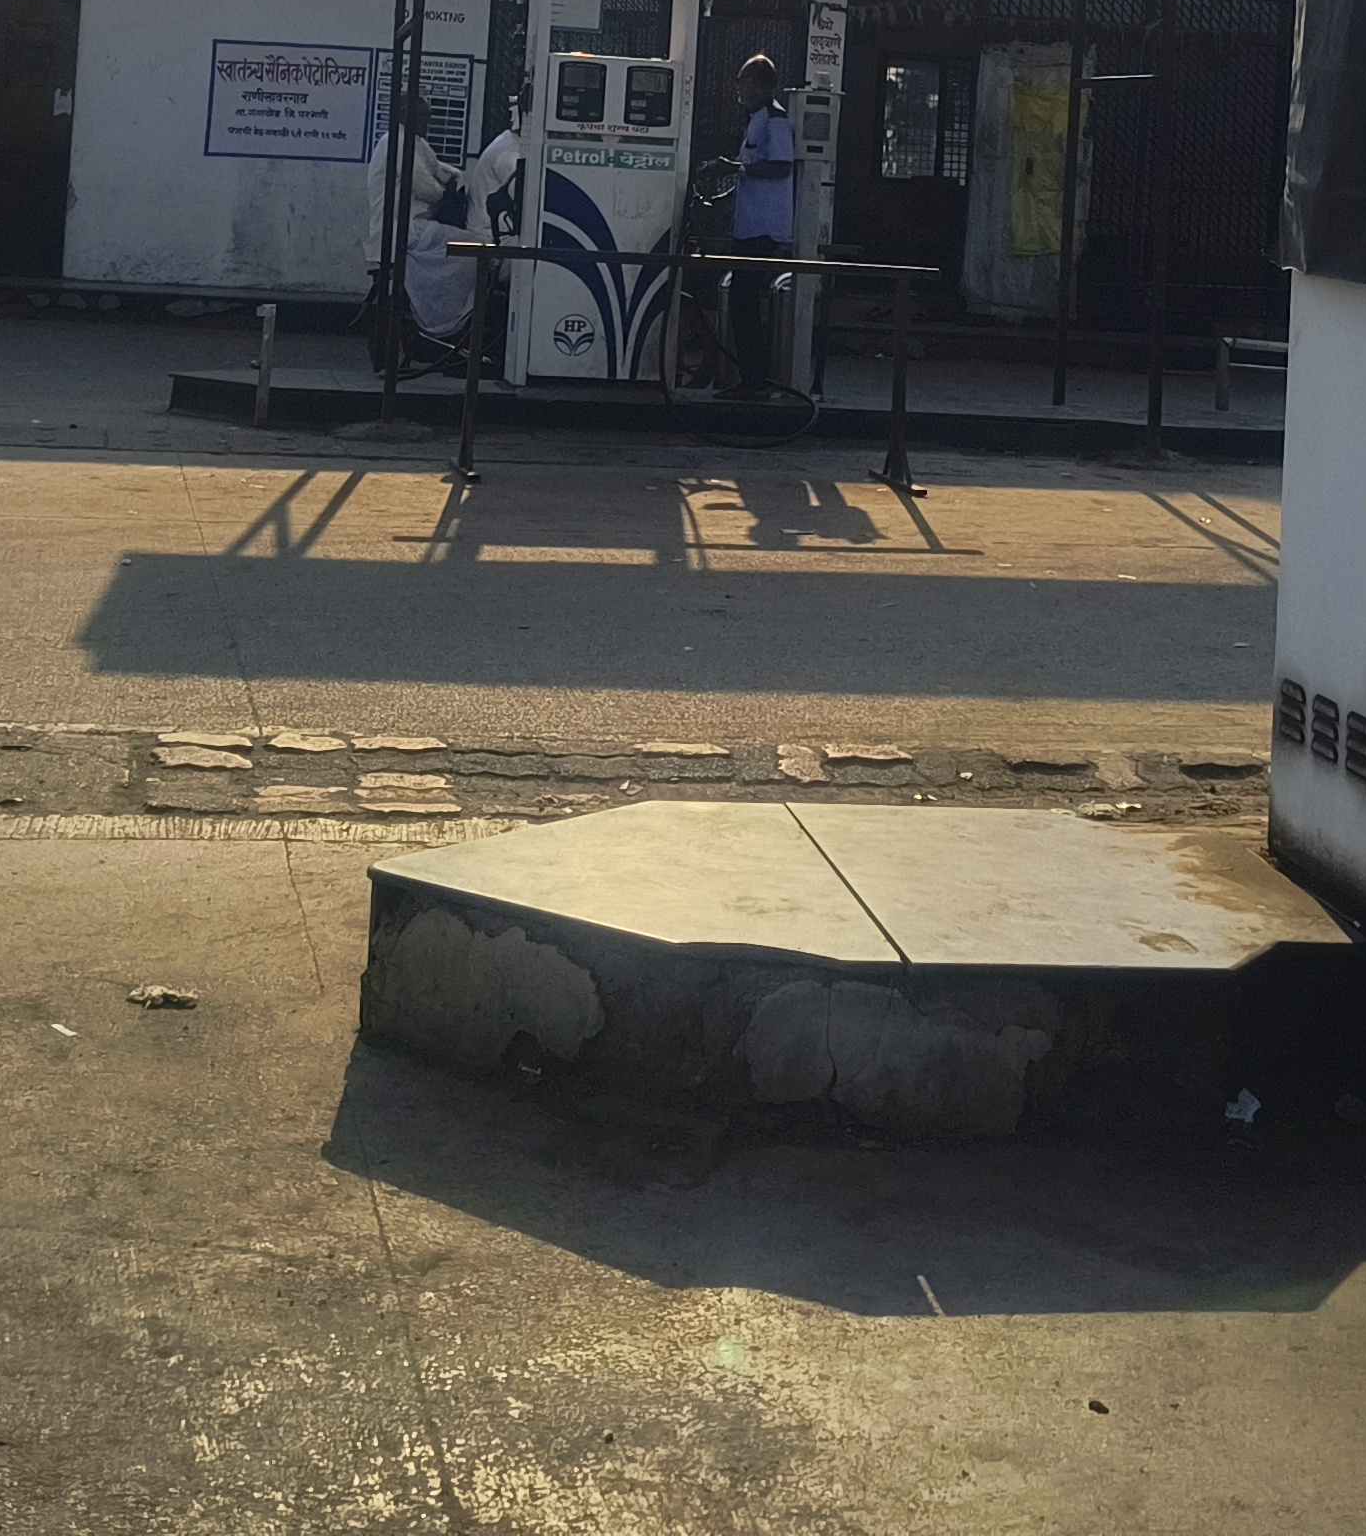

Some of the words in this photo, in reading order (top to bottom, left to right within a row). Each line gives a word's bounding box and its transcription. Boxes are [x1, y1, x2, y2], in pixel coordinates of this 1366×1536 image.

[264, 55, 303, 85] सैनिक
[302, 56, 367, 87] पेट्रोलियम
[551, 148, 605, 165] Petrol
[619, 152, 671, 169] पेट्रोल
[564, 319, 587, 333] HP
